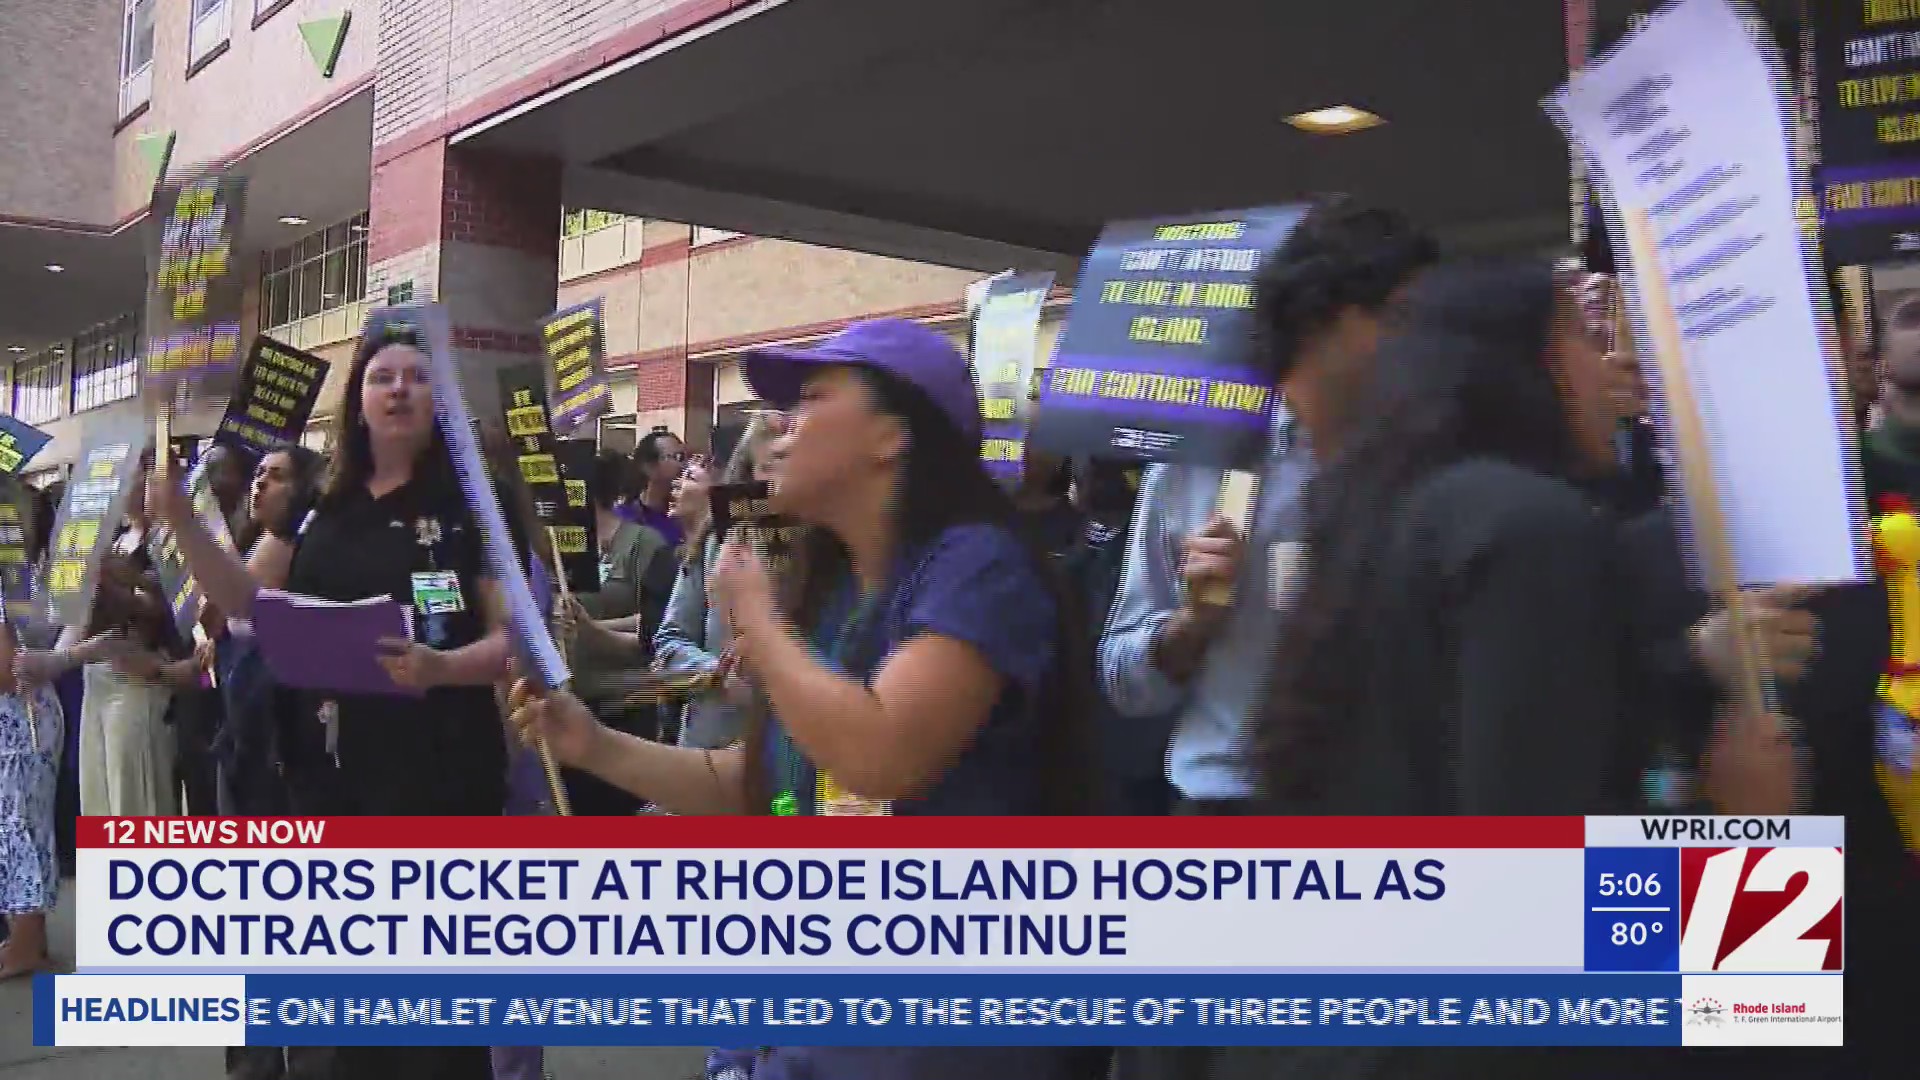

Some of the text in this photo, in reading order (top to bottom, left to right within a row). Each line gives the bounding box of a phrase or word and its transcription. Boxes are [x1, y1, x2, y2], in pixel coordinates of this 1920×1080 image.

[1154, 222, 1246, 242] DOCTORS
[1120, 247, 1261, 272] CAN'T AFFORD
[1101, 280, 1131, 305] TO
[1128, 281, 1176, 306] LIVE
[1172, 282, 1201, 307] IN
[1050, 367, 1272, 415] FAIR CONTRACT NOW!
